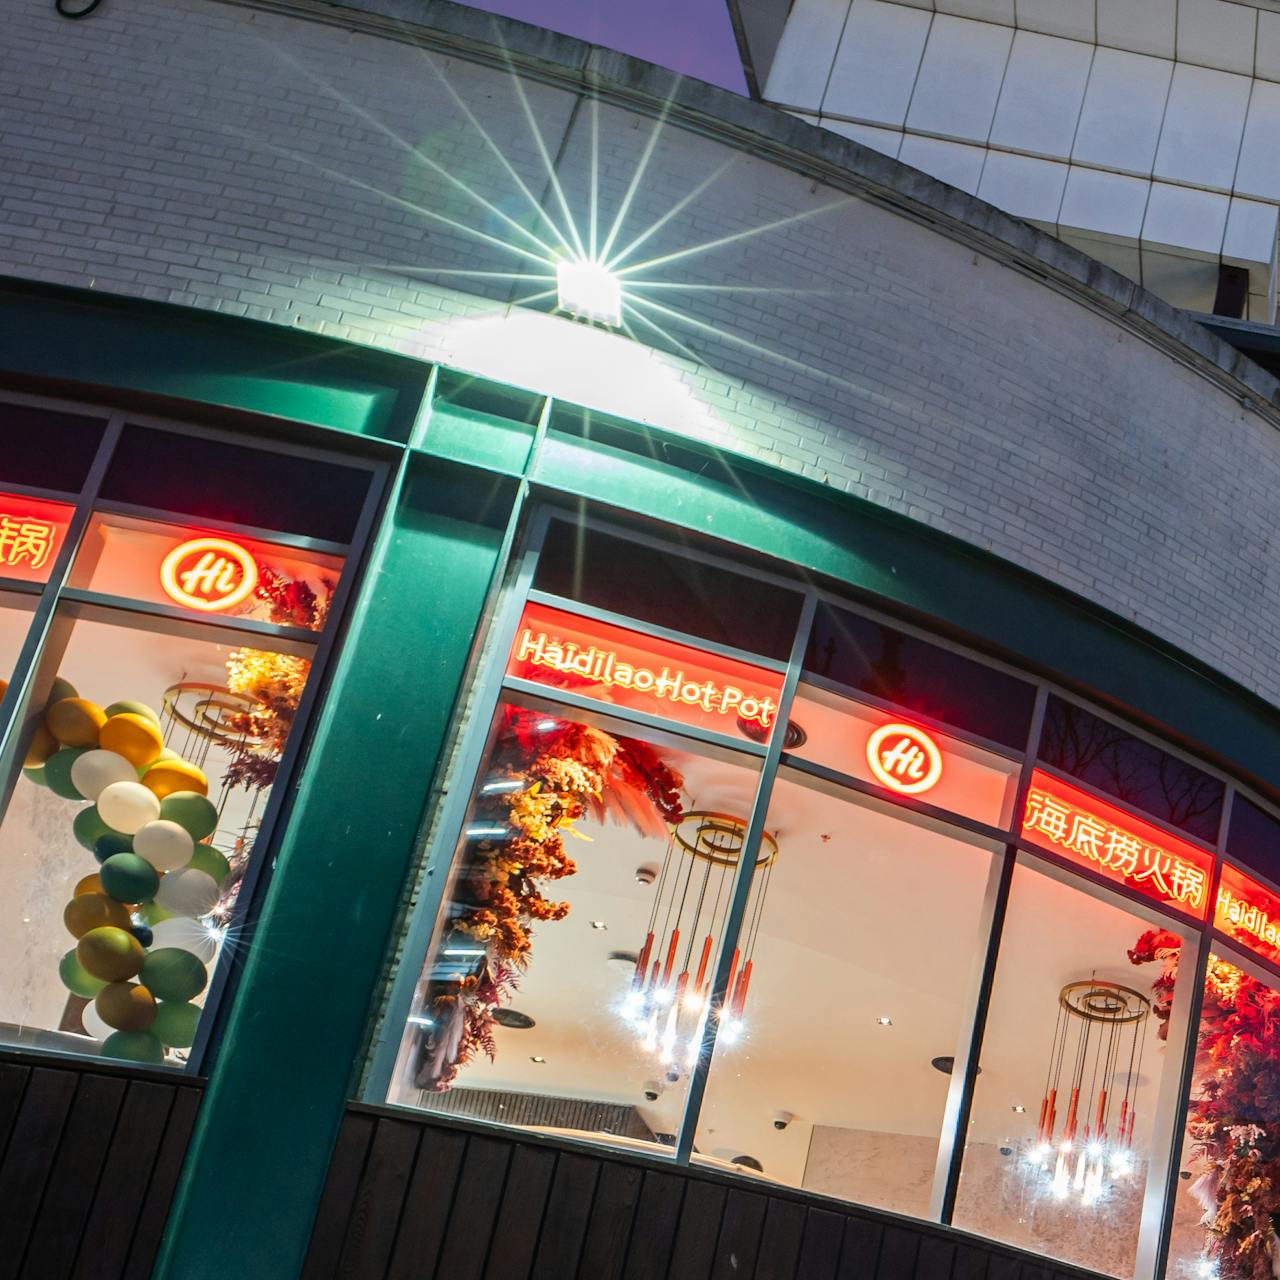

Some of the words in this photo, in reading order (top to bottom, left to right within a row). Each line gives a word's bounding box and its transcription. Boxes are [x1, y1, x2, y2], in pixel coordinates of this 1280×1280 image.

[655, 667, 716, 712] Hot
[717, 685, 777, 727] Pot
[1024, 787, 1207, 910] 海底捞火锅
